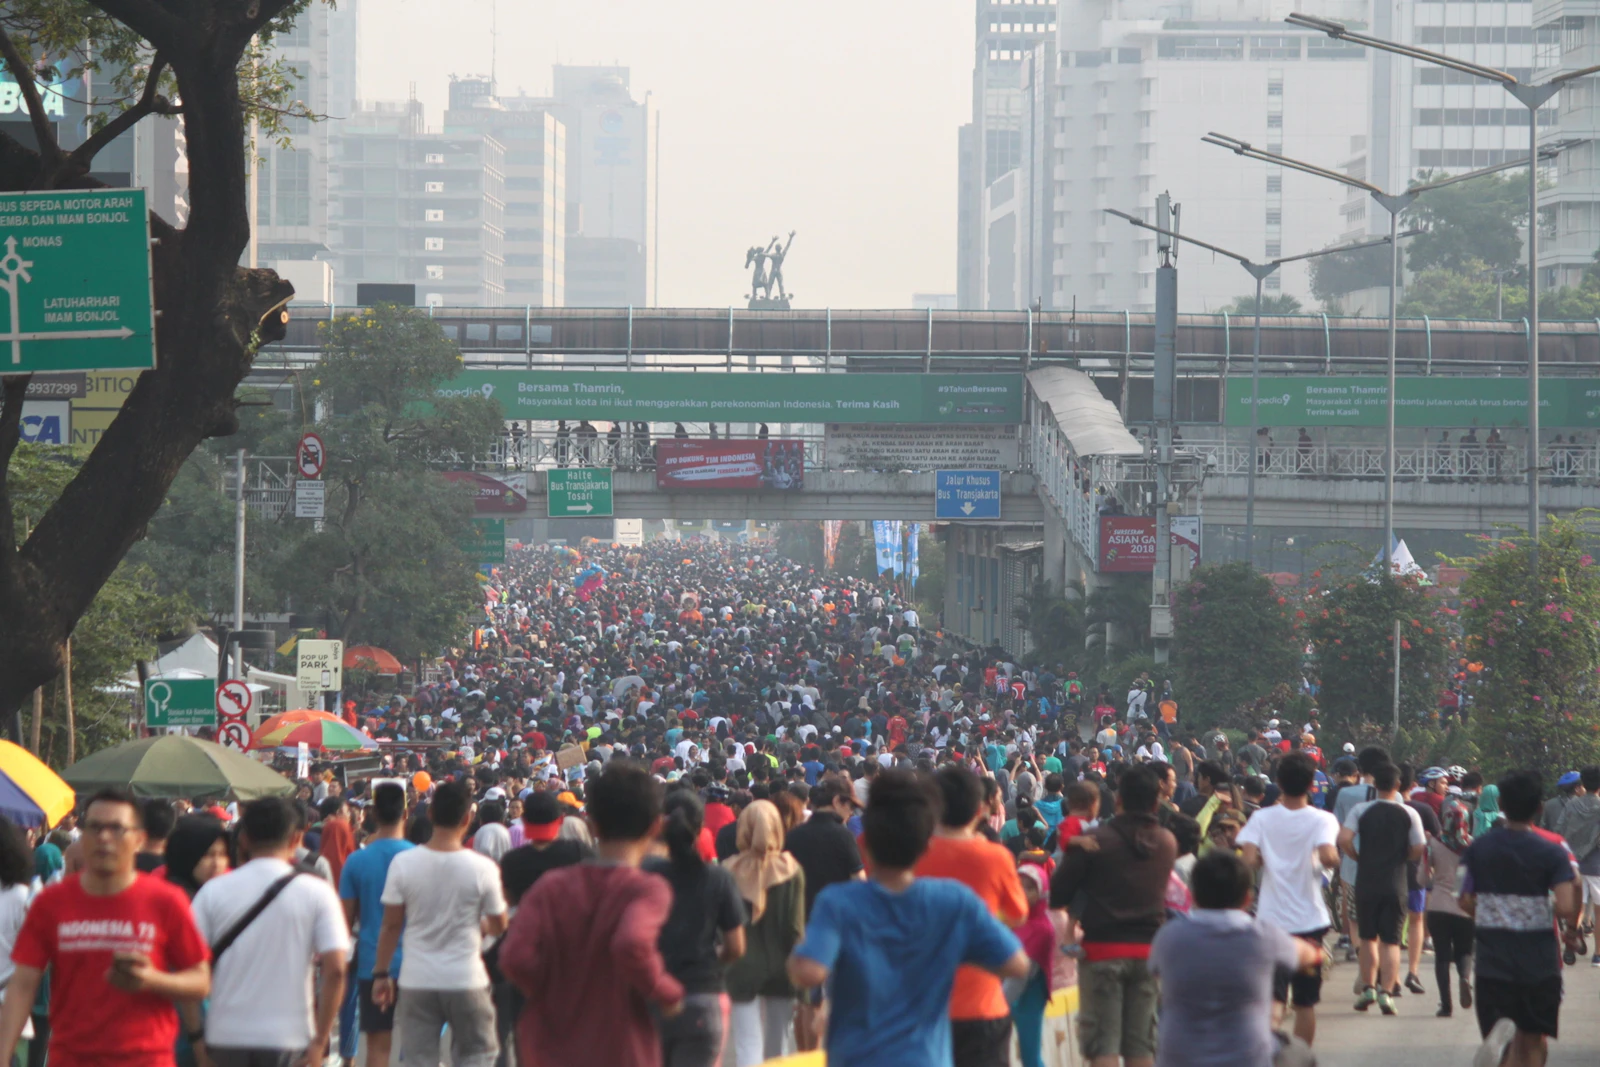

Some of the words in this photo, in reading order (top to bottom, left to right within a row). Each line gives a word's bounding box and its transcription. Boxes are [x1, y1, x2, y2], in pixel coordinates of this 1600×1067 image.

[20, 199, 62, 211] SEPEDA
[64, 198, 101, 210] MOTOR
[104, 197, 133, 209] ARAH
[32, 214, 54, 226] DAN
[57, 213, 84, 225] IMAM
[87, 212, 130, 223] BONJOL
[23, 235, 63, 247] MONAS
[43, 296, 120, 309] LATUHARHARI
[44, 311, 73, 323] IMAM
[75, 309, 120, 322] BONJOL
[518, 382, 569, 393] Bersama
[572, 383, 625, 395] Thamrin,
[938, 385, 1008, 393] #9TahunBersama
[1306, 386, 1348, 395] Bersama
[517, 397, 573, 407] Masyarakat
[575, 397, 598, 406] kota
[600, 397, 613, 406] ini
[614, 398, 633, 407] ikut
[635, 399, 708, 409] menggerakkan
[711, 400, 781, 409] perekonomian
[783, 400, 834, 409] Indonesia.
[836, 400, 871, 409] Terima
[872, 400, 900, 409] Kasih
[1306, 398, 1352, 406] Masyarakat
[1354, 397, 1363, 405] di
[1380, 398, 1425, 406] mmbantu
[1426, 398, 1453, 407] jutaan
[1454, 398, 1478, 406] untuk
[1480, 398, 1501, 406] terus
[1306, 408, 1336, 416] Terima
[1337, 408, 1360, 416] Kasih
[73, 428, 108, 444] NT
[720, 452, 756, 462] INDONESIA
[567, 470, 592, 480] Halte
[946, 474, 965, 485] Jalur
[966, 475, 991, 486] Khusus
[550, 481, 564, 491] Bus
[565, 480, 610, 492] Transjakarta
[480, 489, 501, 497] 2018
[567, 491, 593, 501] Tosari
[937, 488, 951, 500] Bus
[956, 488, 999, 502] Transjakarta
[1107, 535, 1140, 545] ASIAN
[1140, 535, 1178, 545] GAS
[1130, 544, 1156, 554] 2018
[300, 661, 329, 669] PARK
